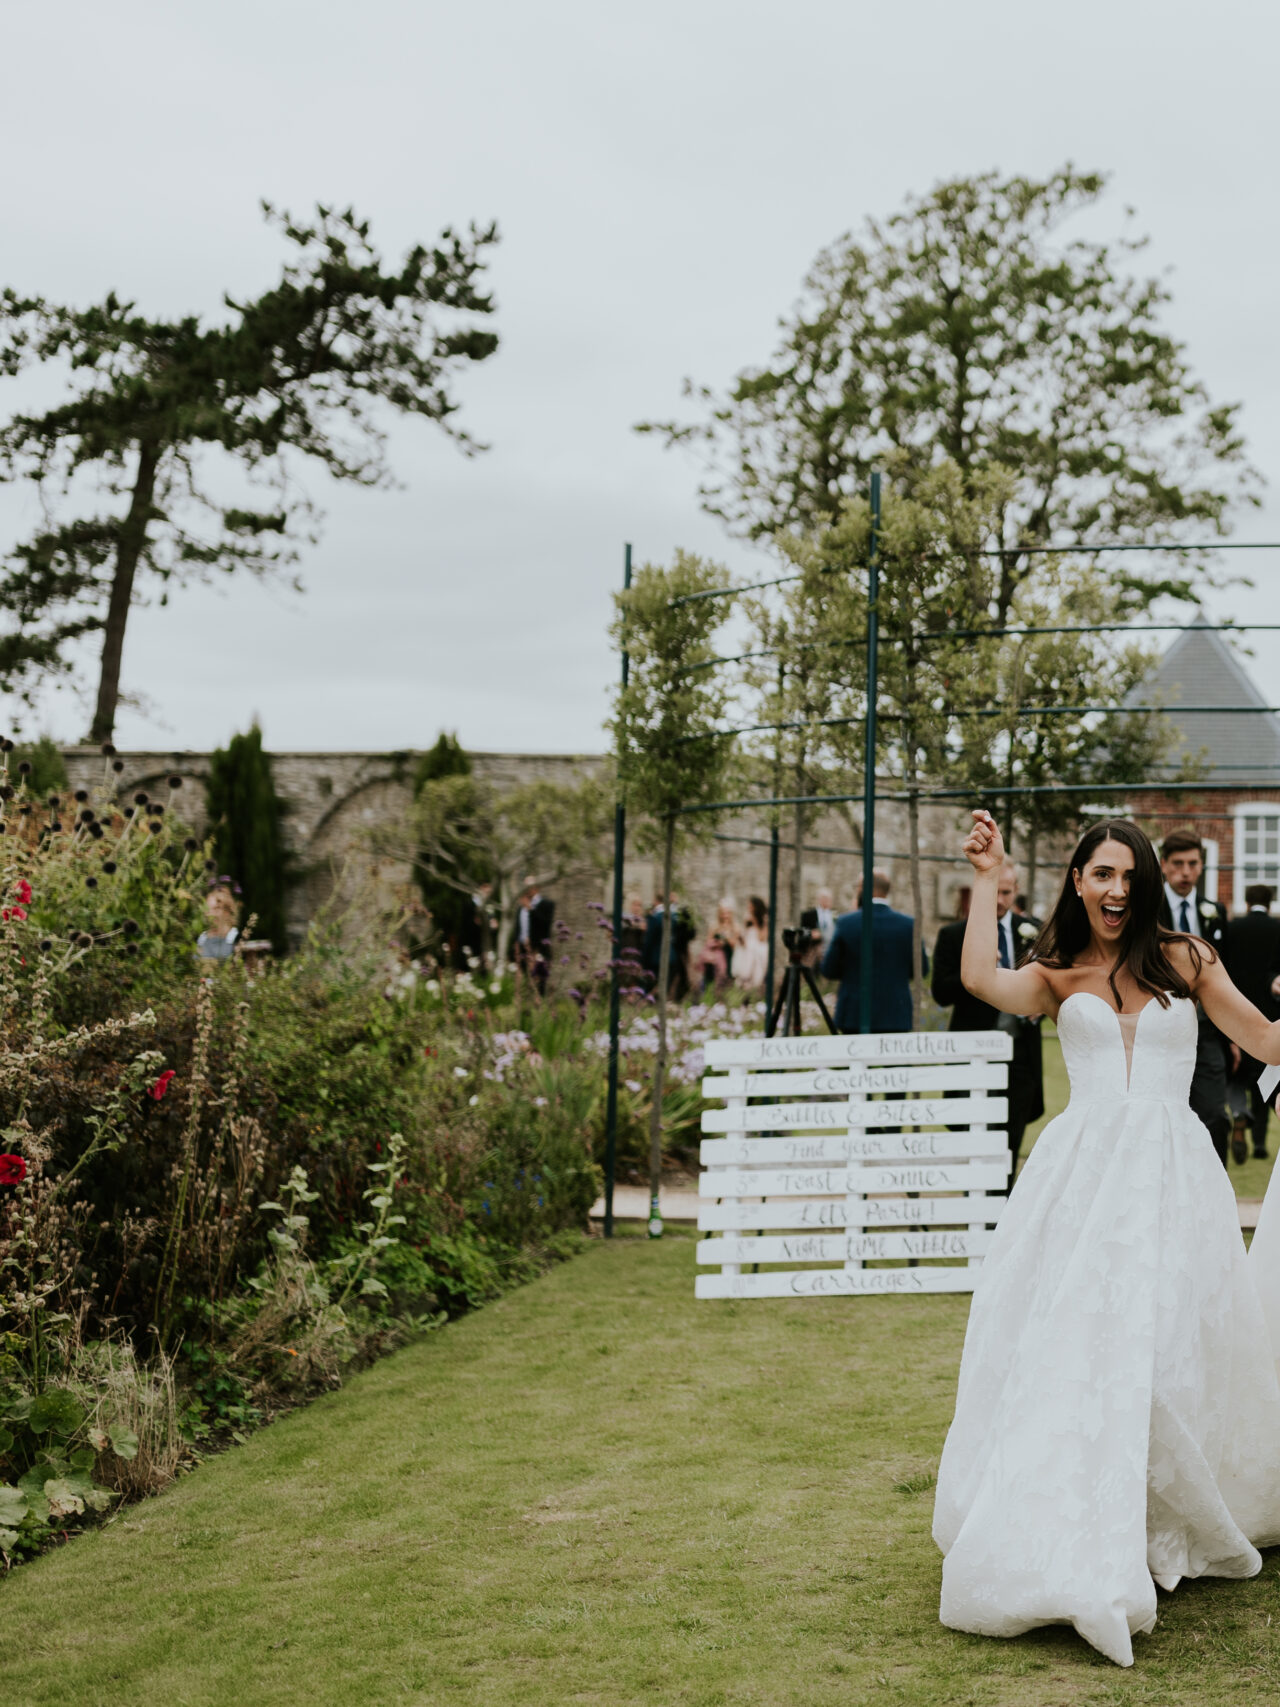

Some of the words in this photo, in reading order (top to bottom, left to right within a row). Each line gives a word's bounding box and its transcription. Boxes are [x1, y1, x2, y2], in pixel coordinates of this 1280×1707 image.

[755, 1041, 821, 1062] Jessica
[875, 1033, 957, 1056] Jonathan
[808, 1070, 914, 1090] Ceremony
[765, 1105, 837, 1128] Bubbles
[874, 1102, 941, 1123] Bites
[784, 1138, 826, 1160] Find
[842, 1138, 885, 1163] your
[877, 1169, 957, 1189] Dinner
[779, 1237, 829, 1260] Night
[900, 1234, 967, 1257] Nibbles
[790, 1271, 926, 1294] Carriages
